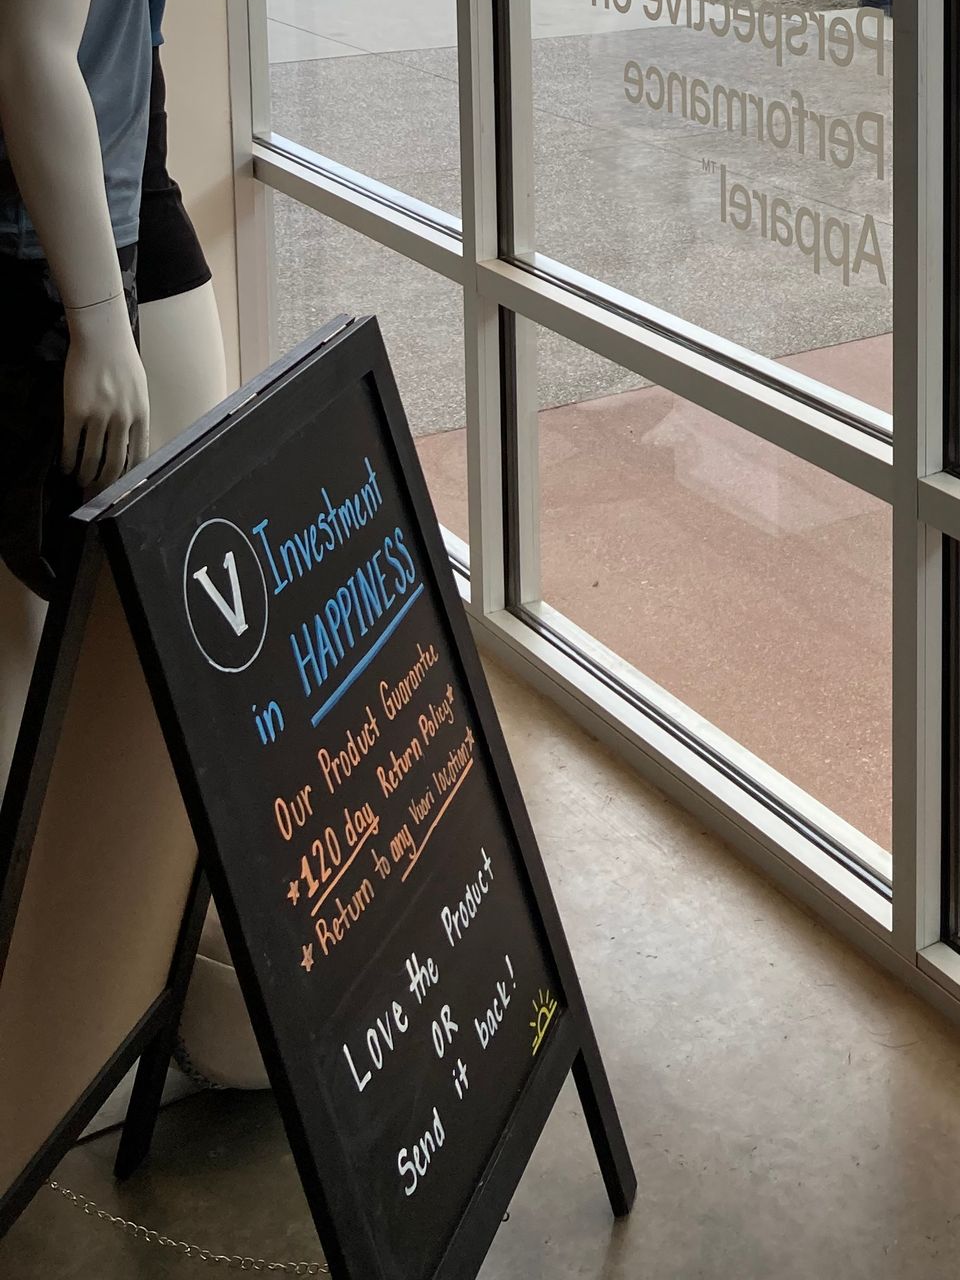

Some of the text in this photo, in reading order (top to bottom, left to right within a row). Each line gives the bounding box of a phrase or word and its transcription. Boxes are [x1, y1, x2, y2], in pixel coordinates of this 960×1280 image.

[252, 457, 383, 595] Investment
[252, 527, 417, 745] in HAPPINESS
[274, 643, 439, 841] Our Product Guarantee
[345, 801, 380, 848] day
[376, 732, 423, 799] Return
[315, 877, 376, 956] Return
[371, 848, 391, 880] to
[389, 823, 418, 861] any
[408, 786, 435, 826] Vuori
[404, 952, 440, 1005] the
[440, 846, 496, 948] Product
[396, 953, 517, 1198] Send it back!
[431, 1003, 460, 1060] OR
